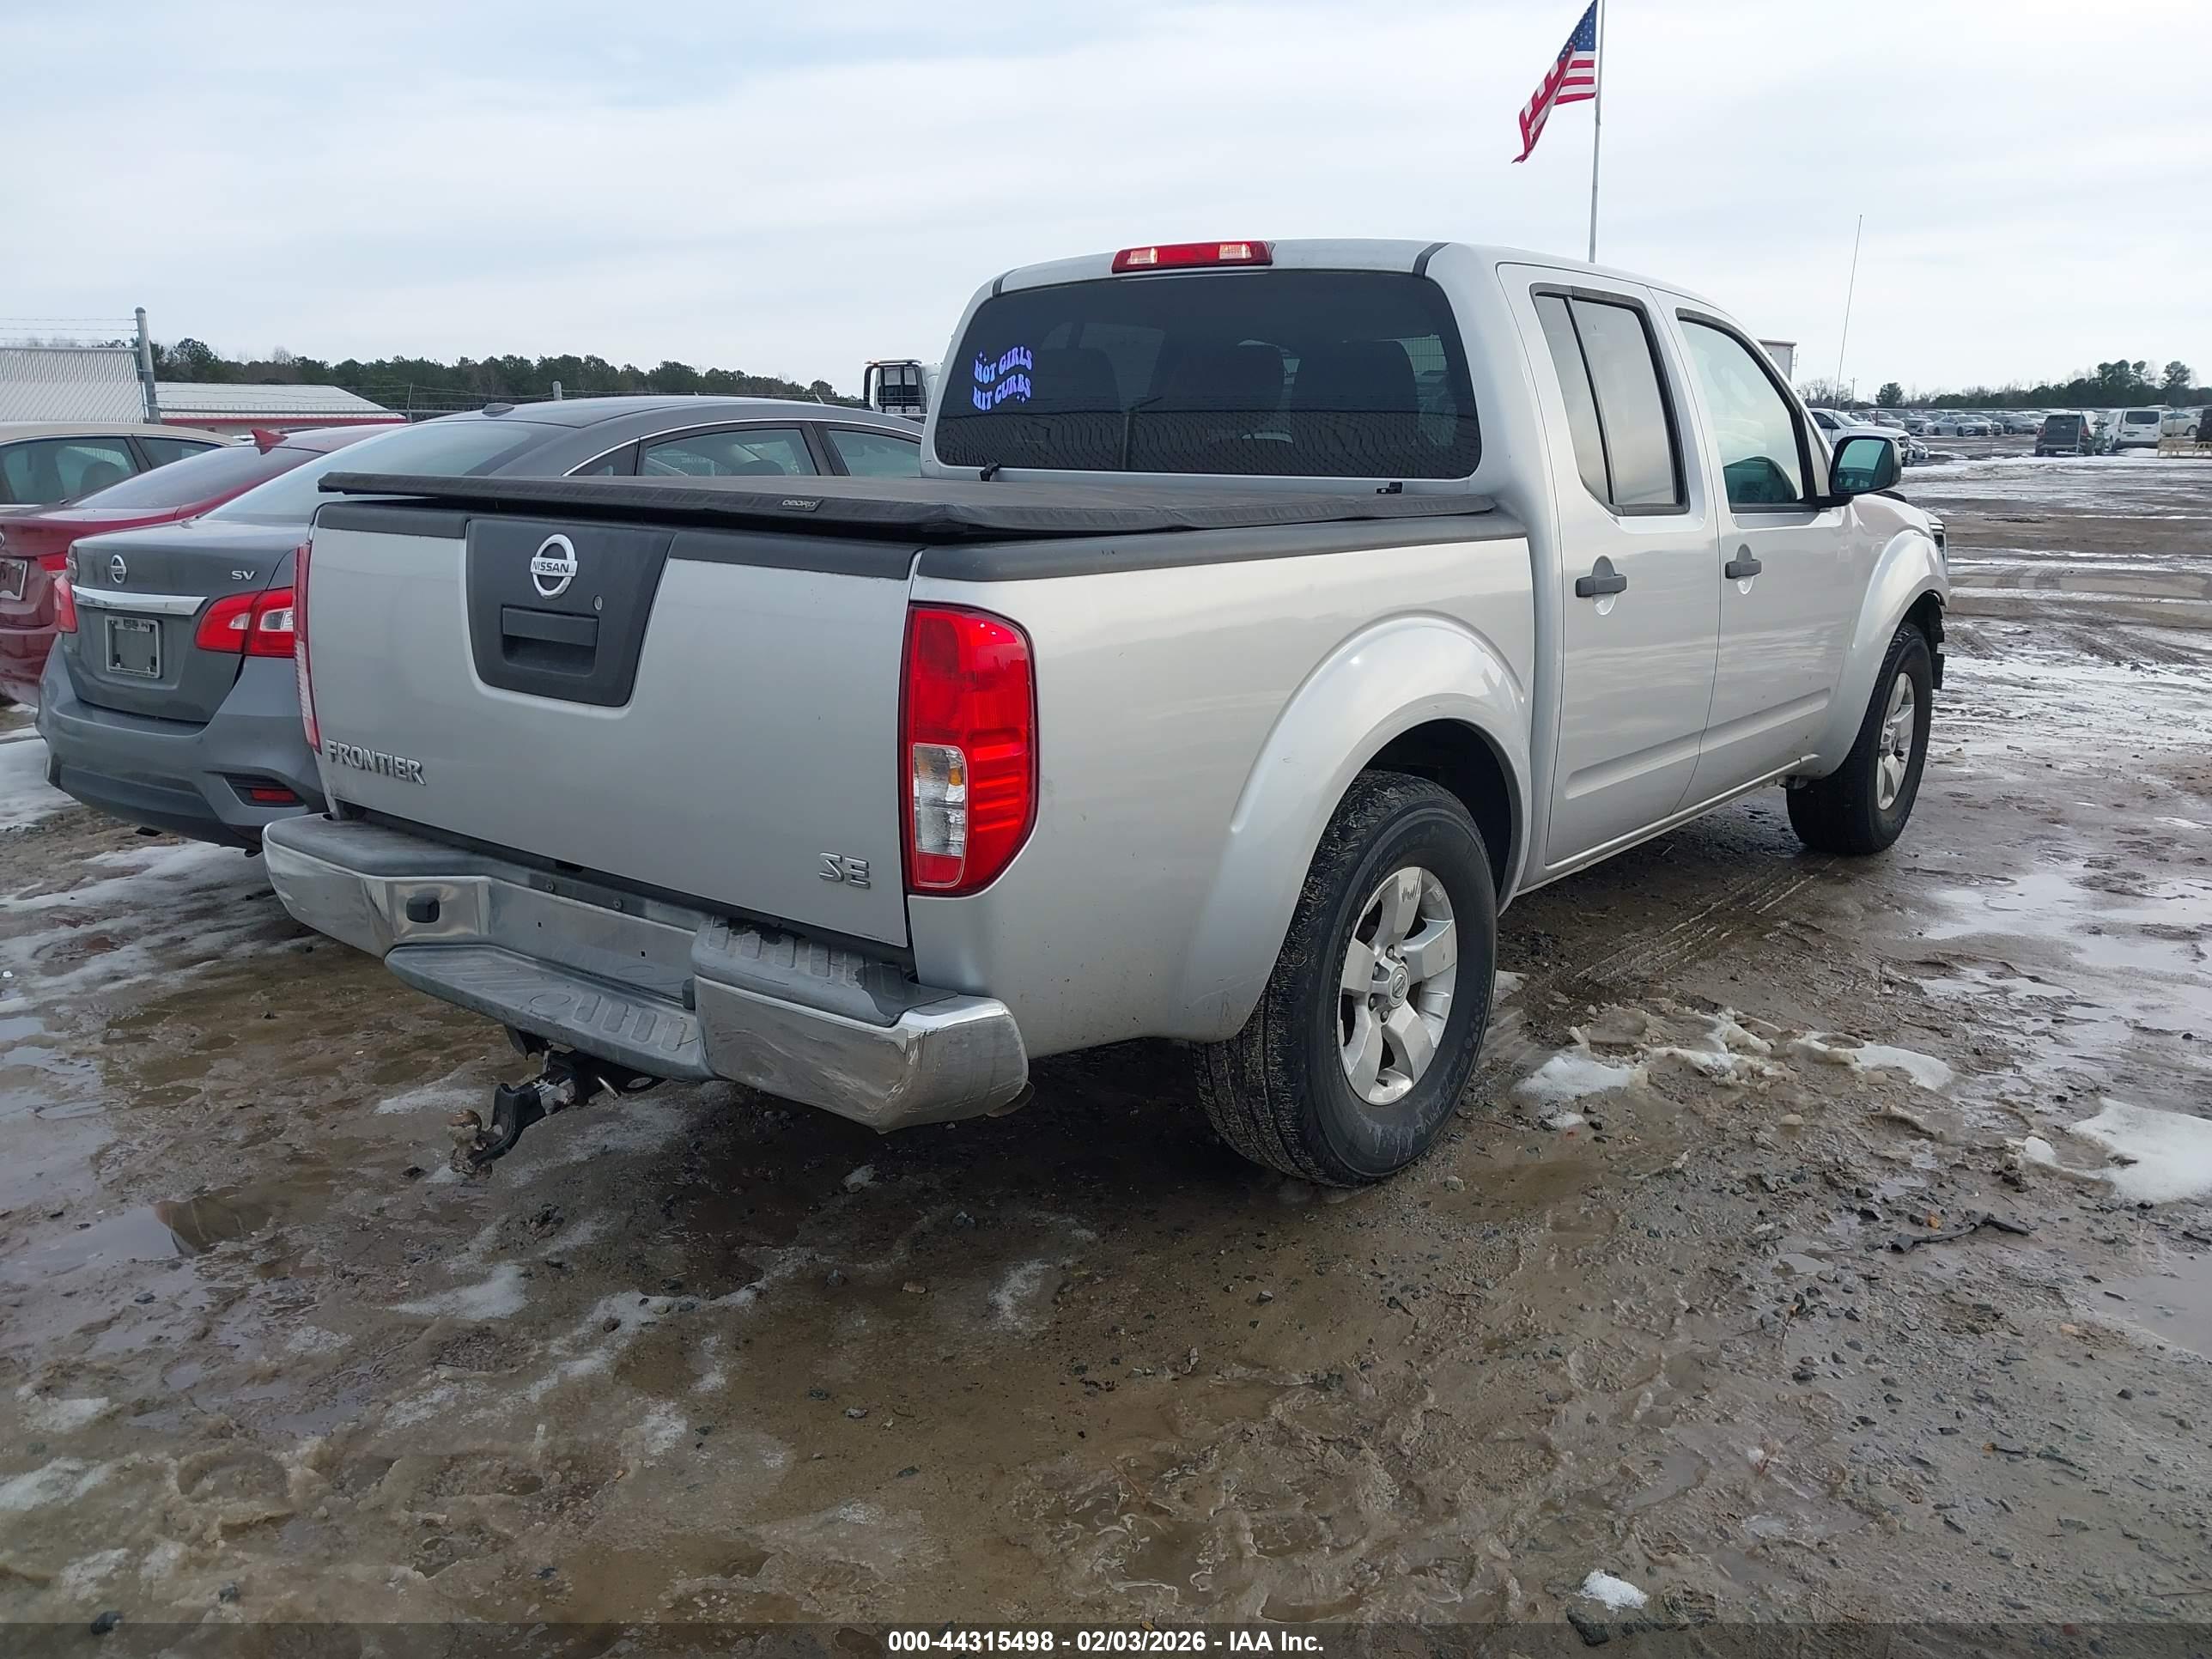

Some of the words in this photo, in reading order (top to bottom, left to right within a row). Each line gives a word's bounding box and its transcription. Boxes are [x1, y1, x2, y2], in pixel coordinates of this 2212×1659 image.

[974, 358, 996, 386] HOT
[998, 345, 1032, 375] GIRLS
[972, 385, 993, 411] HIT
[994, 373, 1031, 404] CURBS
[231, 570, 255, 580] SV
[532, 561, 570, 574] NISSAN
[325, 738, 427, 786] FRONTIER
[818, 851, 871, 890] SE
